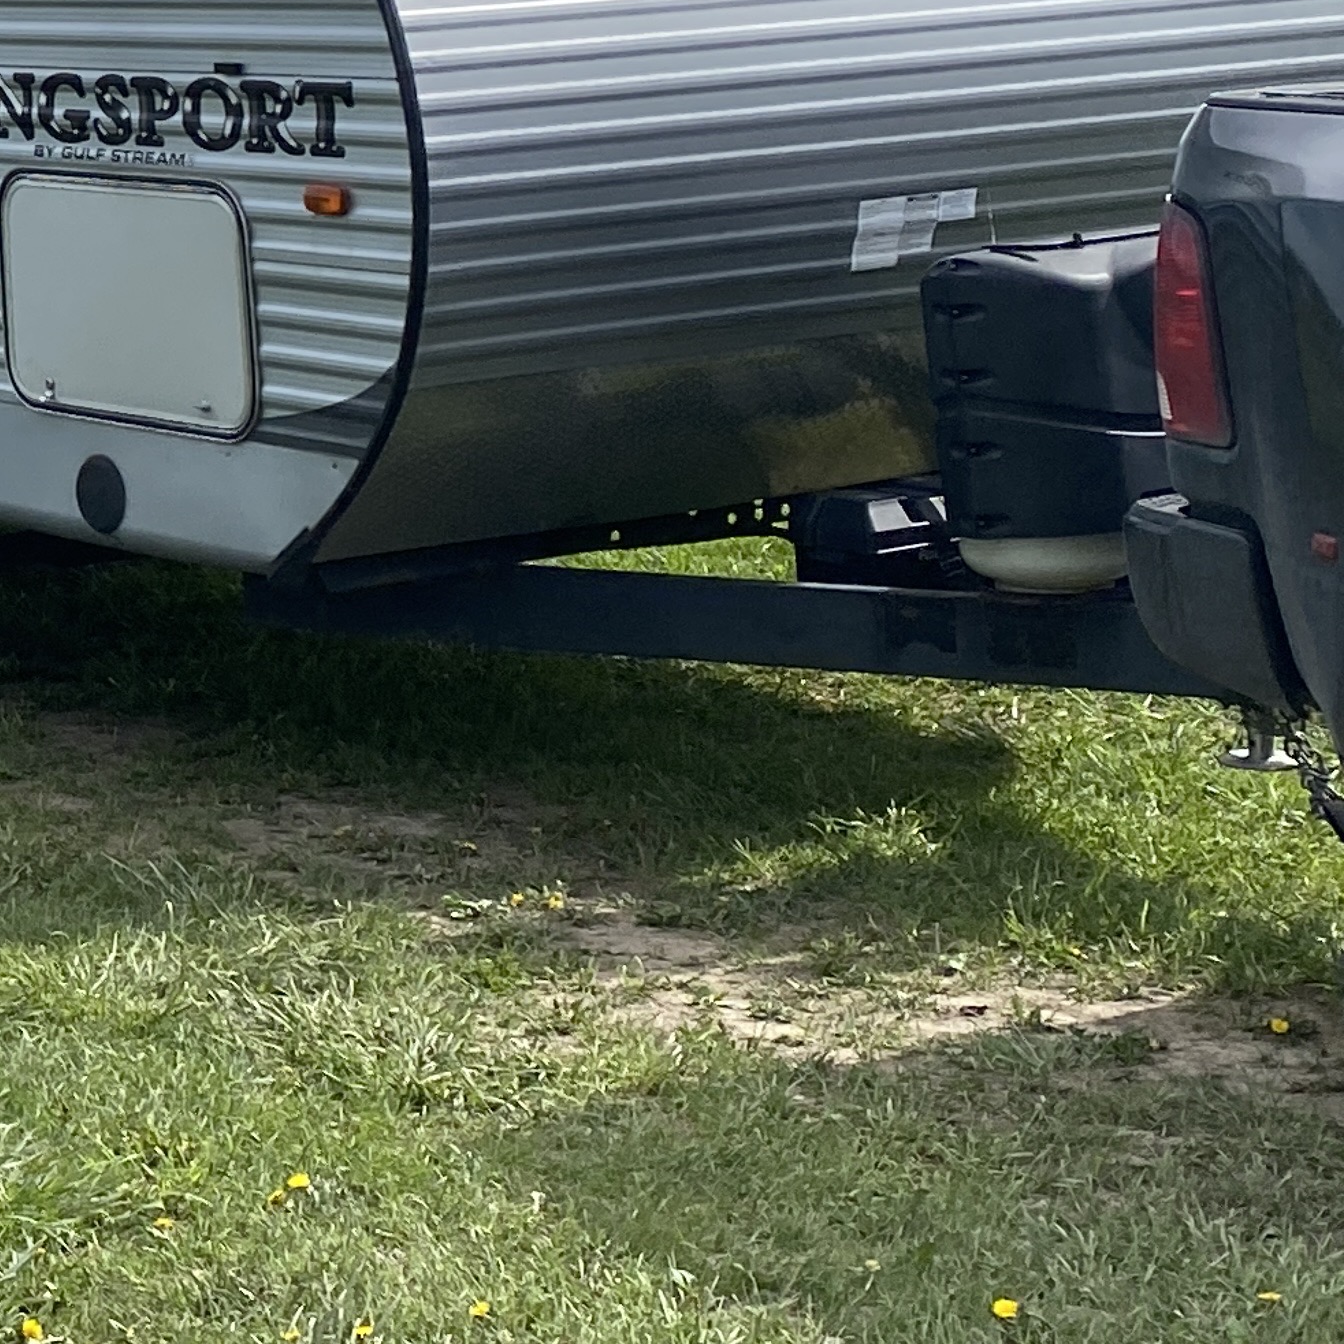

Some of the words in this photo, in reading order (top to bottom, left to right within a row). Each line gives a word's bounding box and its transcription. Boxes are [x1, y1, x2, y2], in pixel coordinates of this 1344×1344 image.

[33, 144, 56, 158] BY
[61, 145, 107, 161] GULF
[111, 148, 186, 167] STREAM
